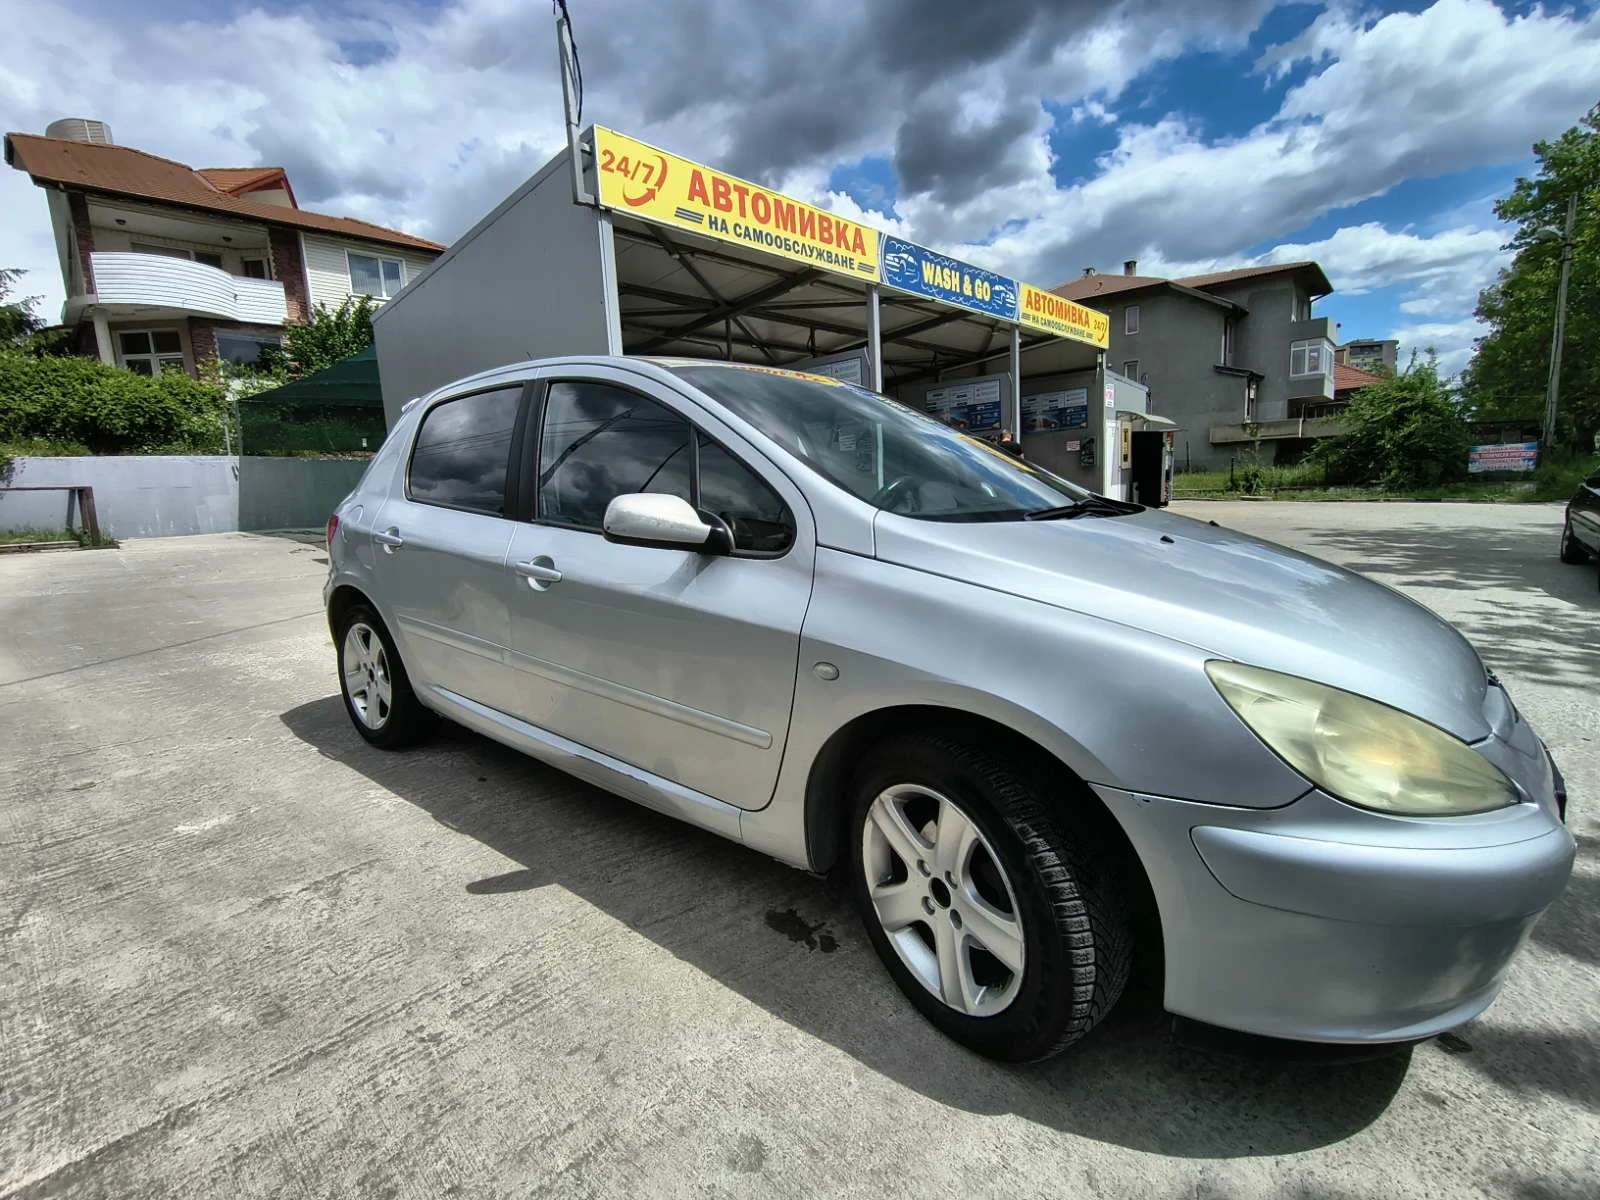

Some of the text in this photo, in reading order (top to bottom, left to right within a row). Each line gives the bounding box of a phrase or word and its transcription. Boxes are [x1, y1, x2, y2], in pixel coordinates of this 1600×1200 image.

[601, 149, 655, 184] 24/7
[688, 169, 866, 256] АВТОМИВКА
[708, 214, 855, 270] НА САМООБСЛУЖВАНЕ
[922, 260, 991, 301] WASH & GO
[1026, 289, 1090, 328] АВТОМИВКА
